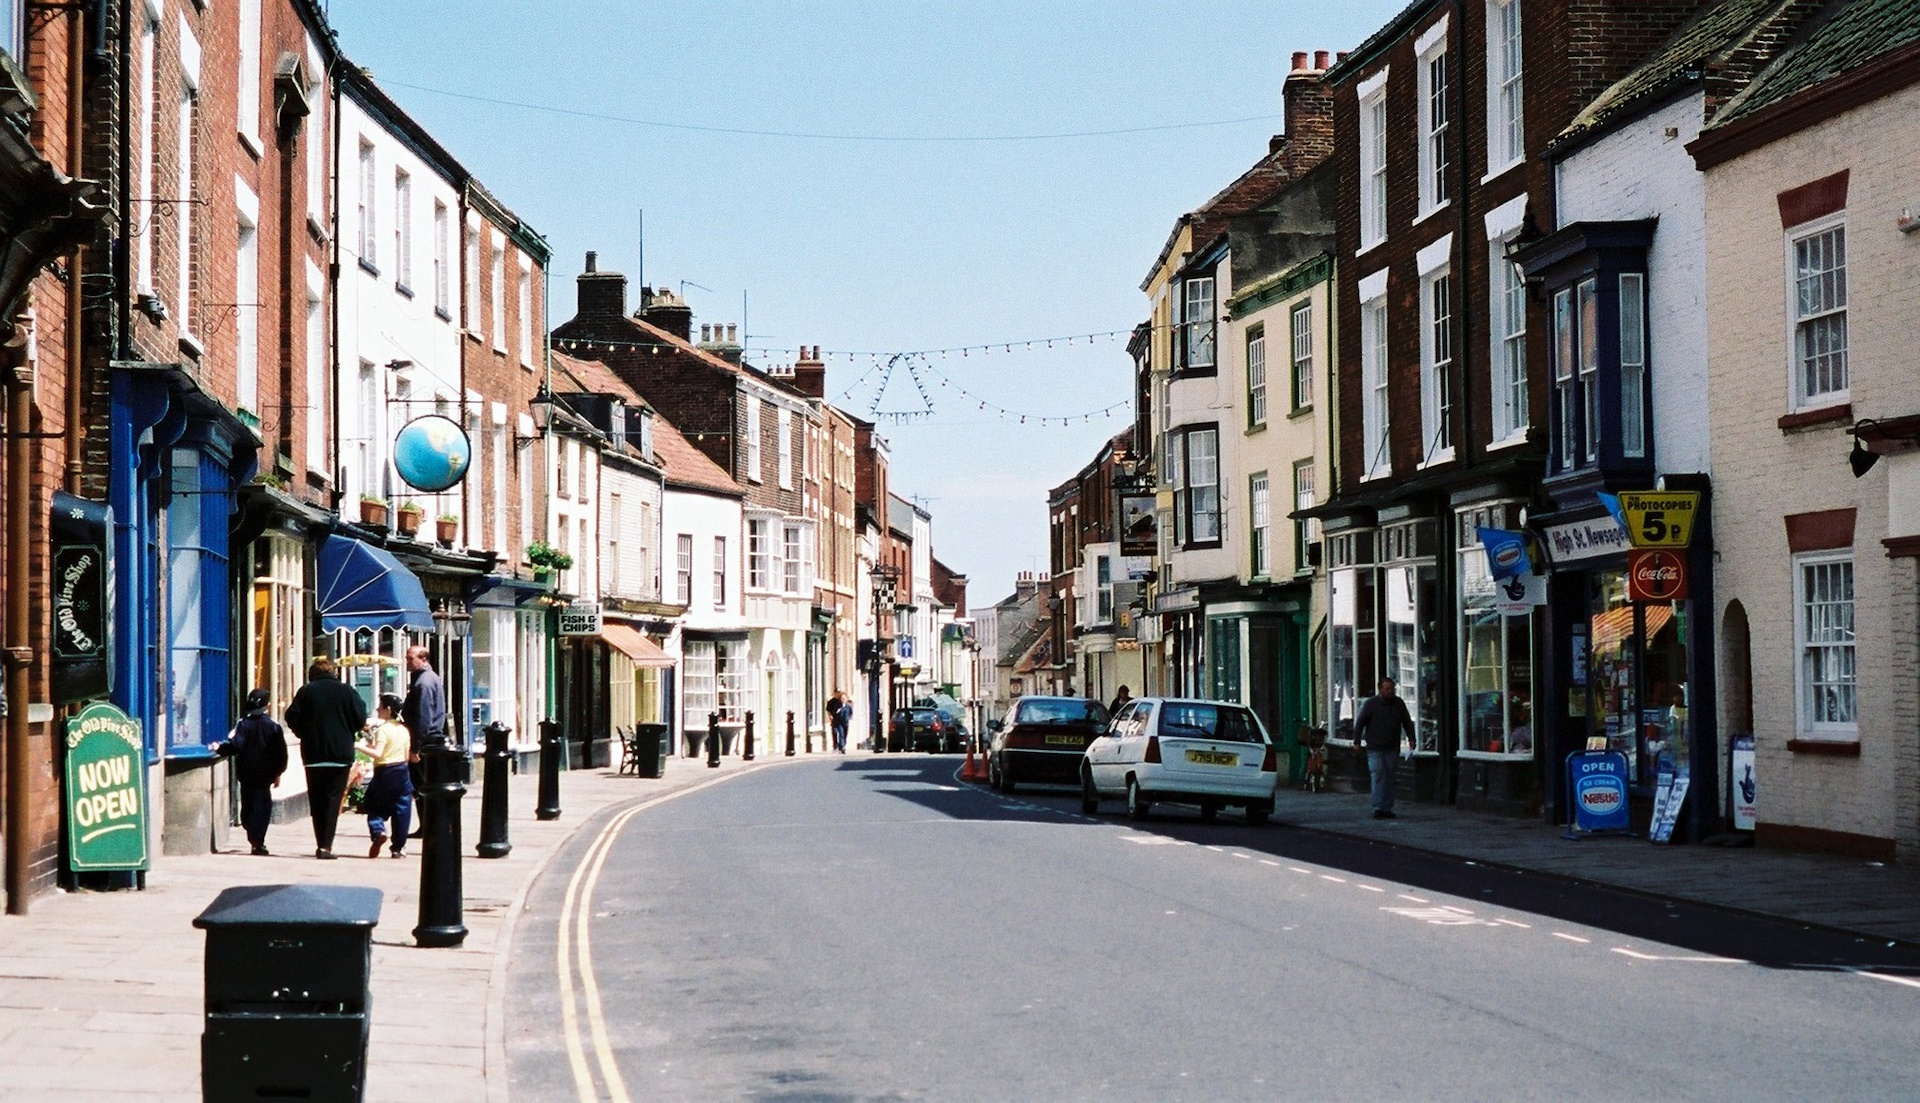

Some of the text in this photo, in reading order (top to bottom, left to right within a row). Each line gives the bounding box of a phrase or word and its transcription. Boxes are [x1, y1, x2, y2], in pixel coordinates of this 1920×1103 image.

[1627, 500, 1692, 510] PHOTOCOPIES
[1552, 529, 1575, 554] High
[1584, 525, 1626, 548] Newsage
[561, 615, 597, 624] FISH &
[563, 624, 596, 632] CHIPS
[1582, 762, 1615, 773] OPEN
[79, 755, 130, 793] NOW
[76, 787, 138, 827] OPEN
